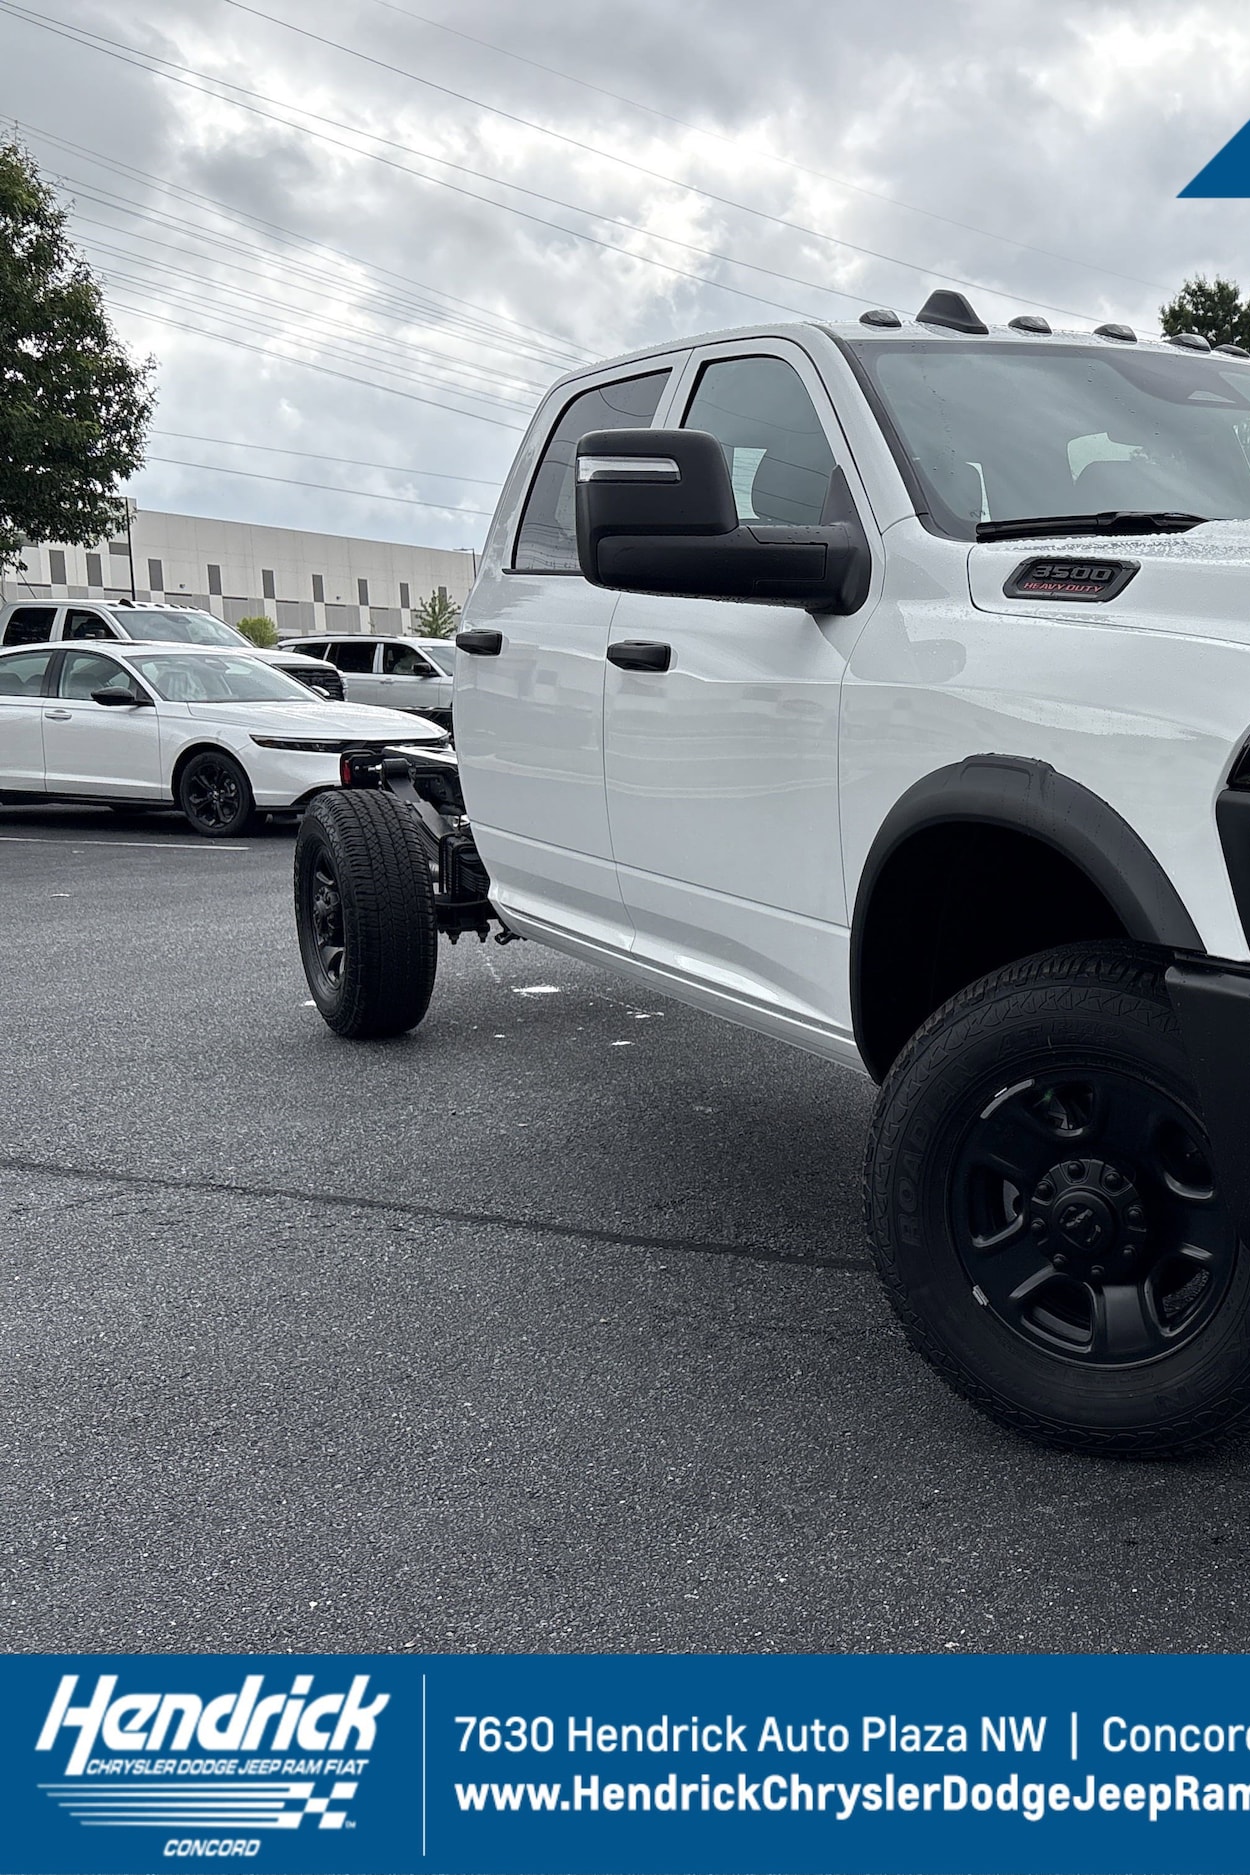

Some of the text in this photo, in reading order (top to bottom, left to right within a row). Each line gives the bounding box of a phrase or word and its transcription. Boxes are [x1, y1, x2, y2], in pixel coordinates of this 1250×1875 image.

[1032, 565, 1113, 581] 3500
[1023, 582, 1105, 593] HEAVY DUTY
